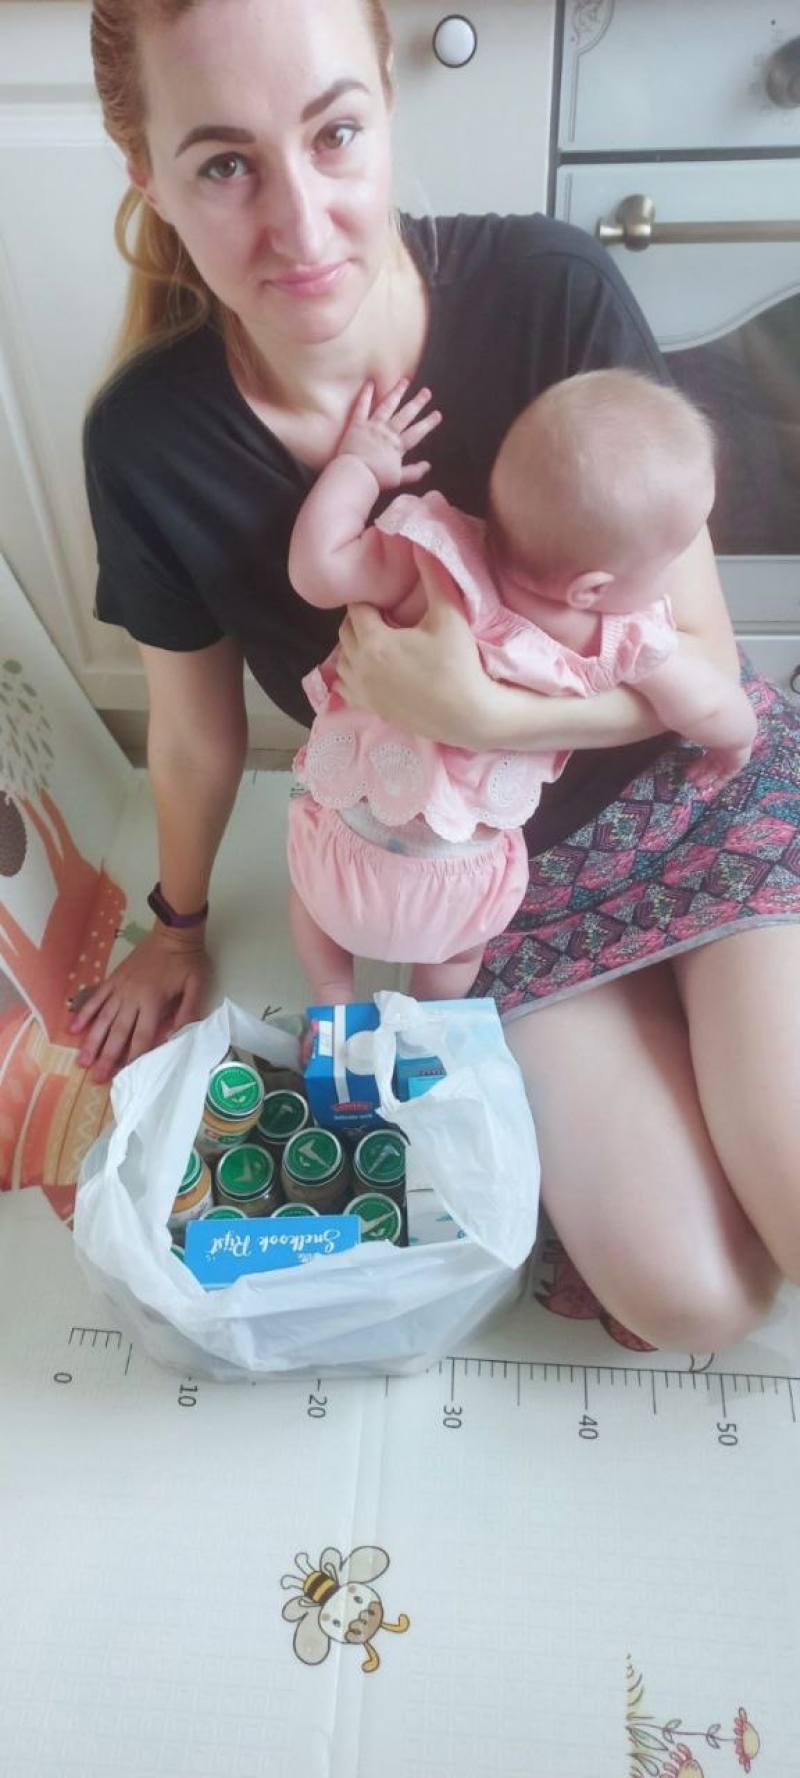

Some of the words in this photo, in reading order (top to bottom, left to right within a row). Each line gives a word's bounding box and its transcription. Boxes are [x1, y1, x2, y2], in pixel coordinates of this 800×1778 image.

[207, 1230, 250, 1258] Rijst
[259, 1229, 340, 1254] Snelkook
[177, 1383, 198, 1408] 10
[307, 1394, 328, 1419] 20
[443, 1405, 463, 1429] 30
[578, 1414, 598, 1440] 40
[717, 1422, 738, 1447] 50
